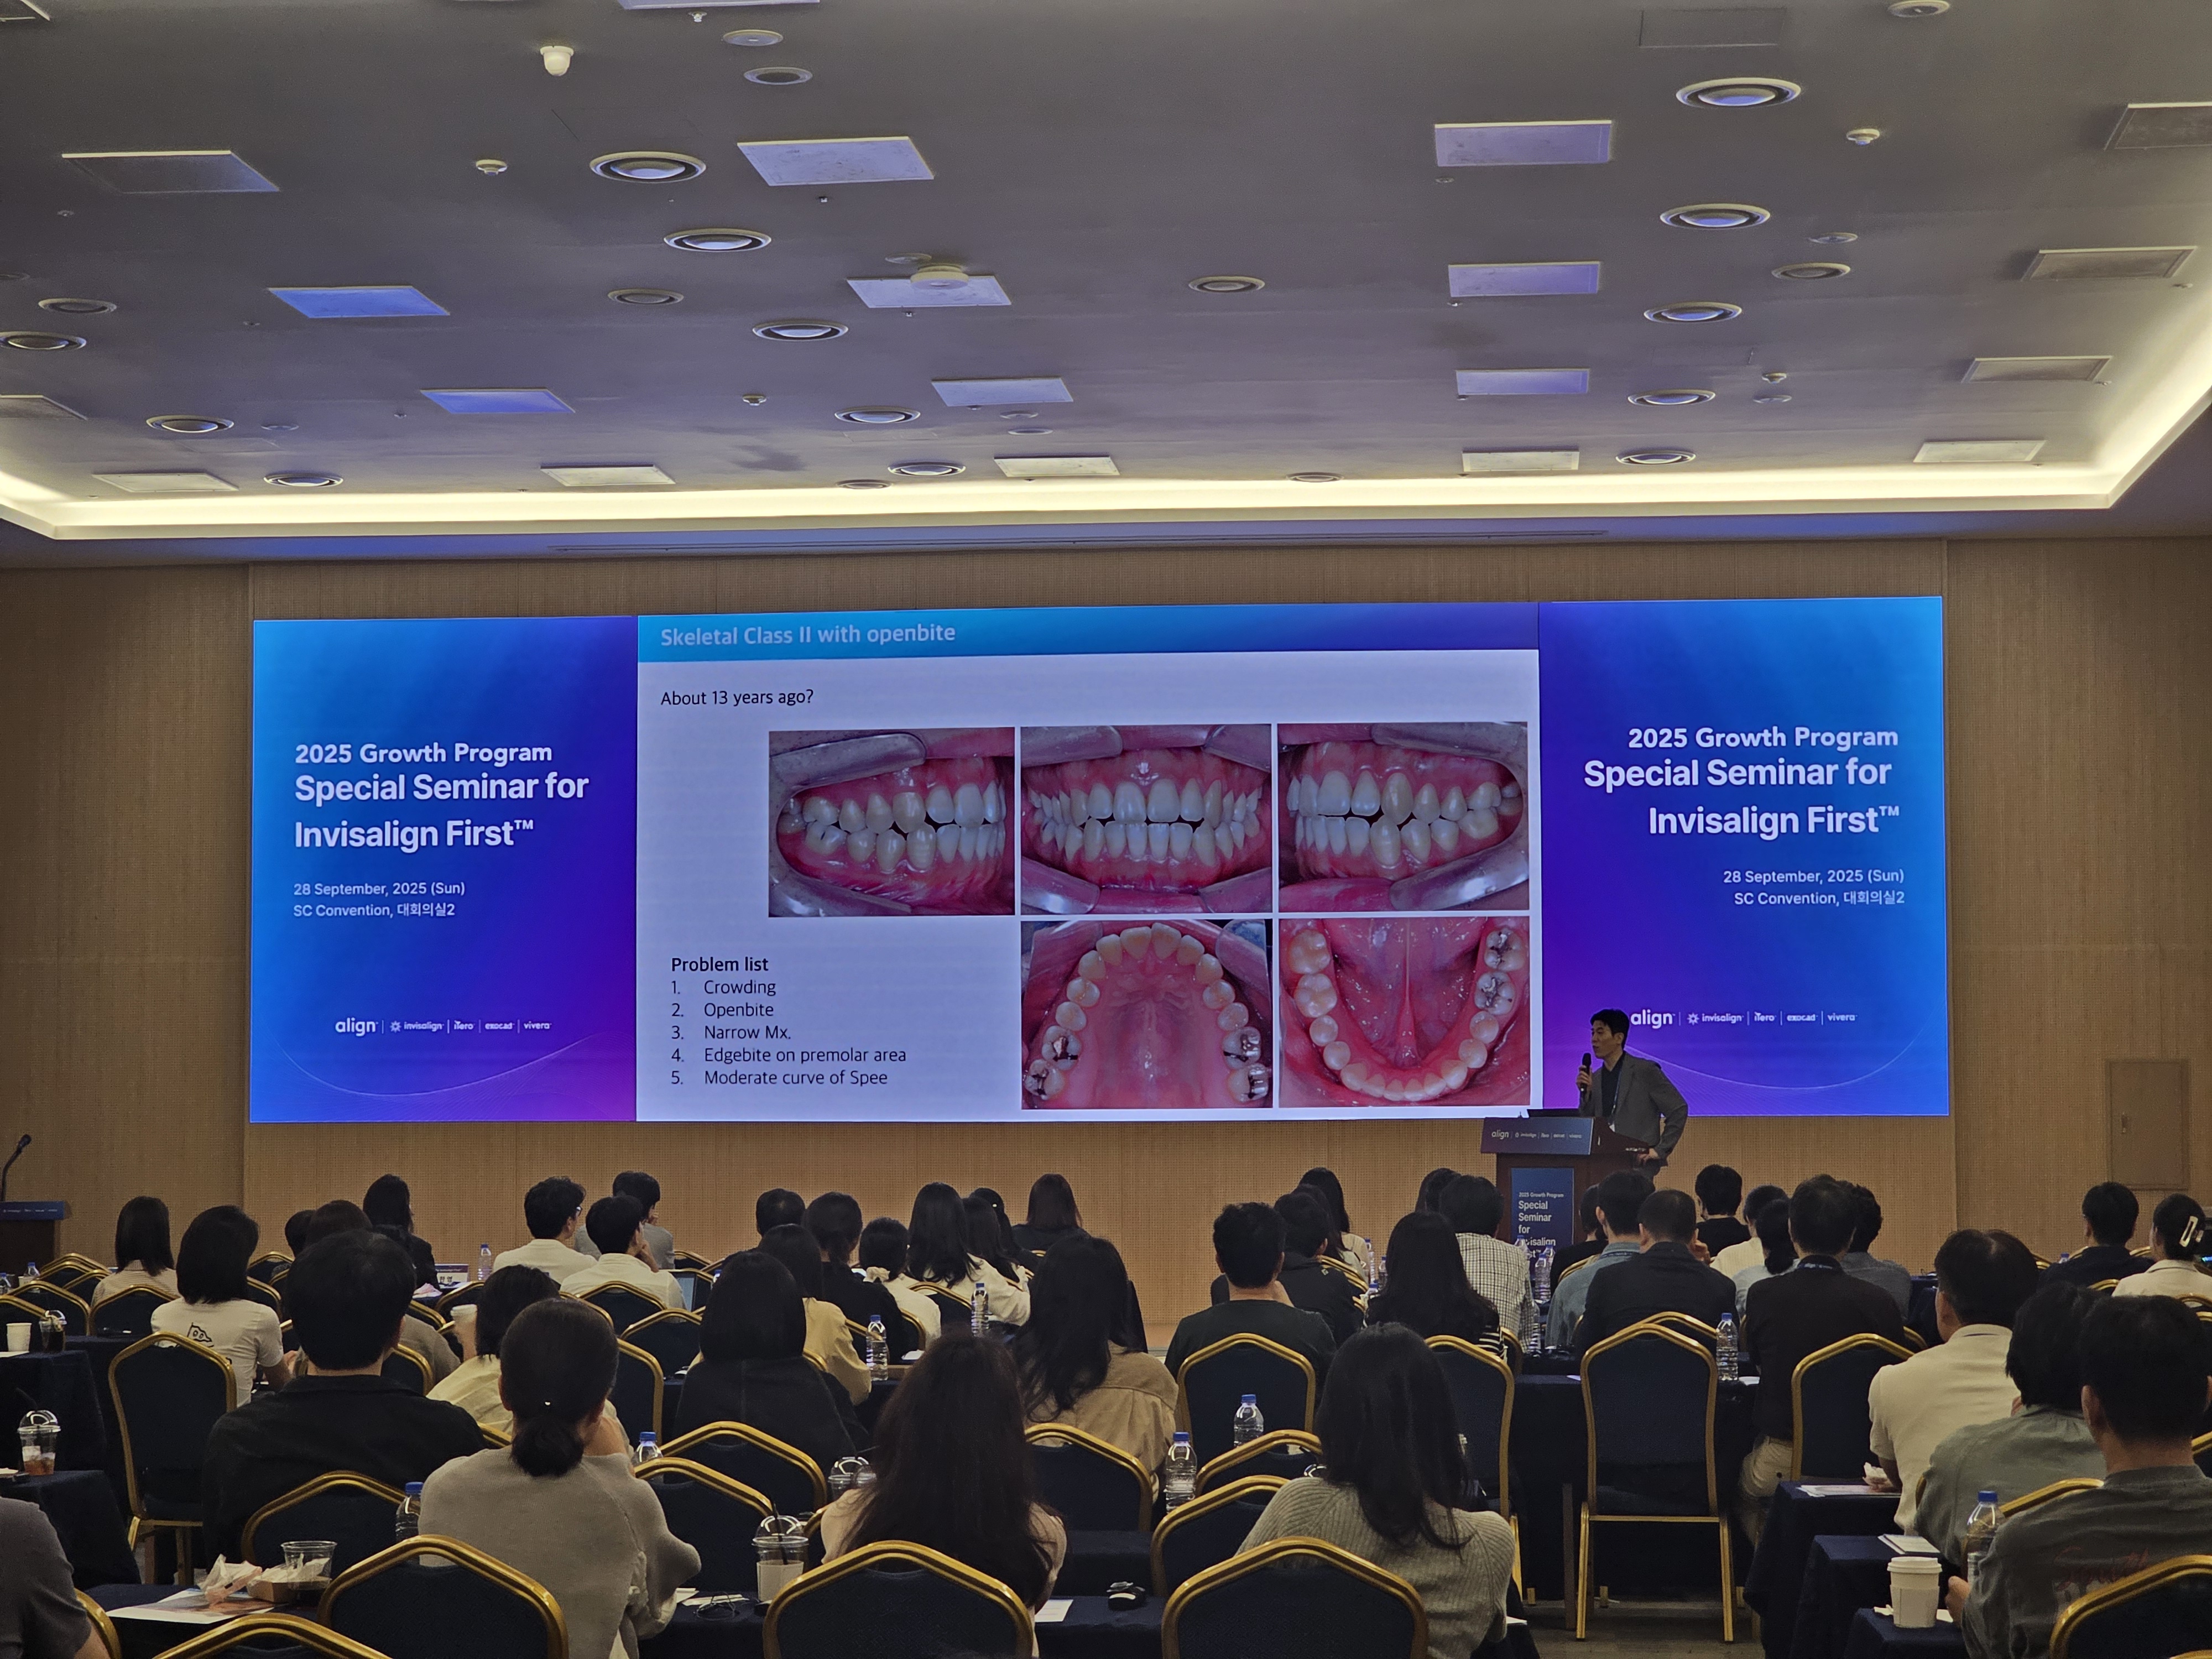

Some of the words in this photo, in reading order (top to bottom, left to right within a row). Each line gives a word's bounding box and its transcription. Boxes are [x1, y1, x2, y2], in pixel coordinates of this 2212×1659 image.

[661, 627, 737, 645] Skeletal
[744, 627, 792, 644] Class
[818, 624, 860, 642] with
[867, 624, 955, 645] openbite
[661, 691, 706, 705] About
[713, 691, 727, 704] 13
[734, 693, 773, 706] years
[779, 689, 813, 706] ago?
[1629, 728, 1687, 748] 2025
[1696, 726, 1786, 747] Growth
[1796, 727, 1898, 752] Program
[296, 744, 351, 763] 2025
[360, 742, 446, 763] Growth
[455, 743, 551, 767] Program
[1584, 759, 1698, 793] Special
[1707, 758, 1839, 785] Seminar
[1845, 757, 1892, 784] for
[295, 774, 404, 807] Special
[414, 773, 538, 799] Seminar
[545, 772, 589, 798] for
[1650, 806, 1798, 840] Invisalign
[296, 820, 437, 853] Invisalign
[1724, 871, 1741, 883] 28
[1745, 871, 1822, 885] September,
[1828, 870, 1863, 882] 2025
[1868, 869, 1903, 883] (Sun)
[294, 884, 310, 895] 28
[315, 883, 388, 897] September,
[393, 883, 426, 894] 2025
[431, 882, 465, 895] (Sun)
[1735, 893, 1754, 904] SC
[1758, 892, 1839, 906] Convention,
[1844, 890, 1905, 905] 대회의실2
[294, 905, 312, 916] SC
[316, 904, 393, 918] Convention,
[398, 902, 455, 916] 대회의실2
[672, 957, 738, 971] Problem
[745, 957, 768, 971] list
[672, 981, 680, 994] 1.
[705, 980, 776, 996] Crowding
[672, 1003, 684, 1016] 2.
[705, 1003, 773, 1019] Openbite
[1631, 1009, 1672, 1029] align
[336, 1018, 375, 1036] align
[672, 1026, 684, 1039] 3.
[705, 1026, 759, 1039] Narrow
[766, 1026, 790, 1039] Mx.
[672, 1048, 684, 1061] 4.
[706, 1047, 770, 1064] Edgebite
[776, 1051, 795, 1062] on
[801, 1047, 868, 1064] premolar
[874, 1051, 906, 1062] area
[672, 1071, 682, 1084] 5.
[706, 1070, 777, 1084] Moderate
[782, 1073, 825, 1084] curve
[830, 1070, 845, 1084] of
[851, 1071, 887, 1086] Spee
[1491, 1130, 1509, 1140] align
[1518, 1200, 1548, 1212] Special
[1518, 1212, 1552, 1222] Seminar
[1518, 1224, 1531, 1234] for
[1519, 1237, 1556, 1246] visalin
